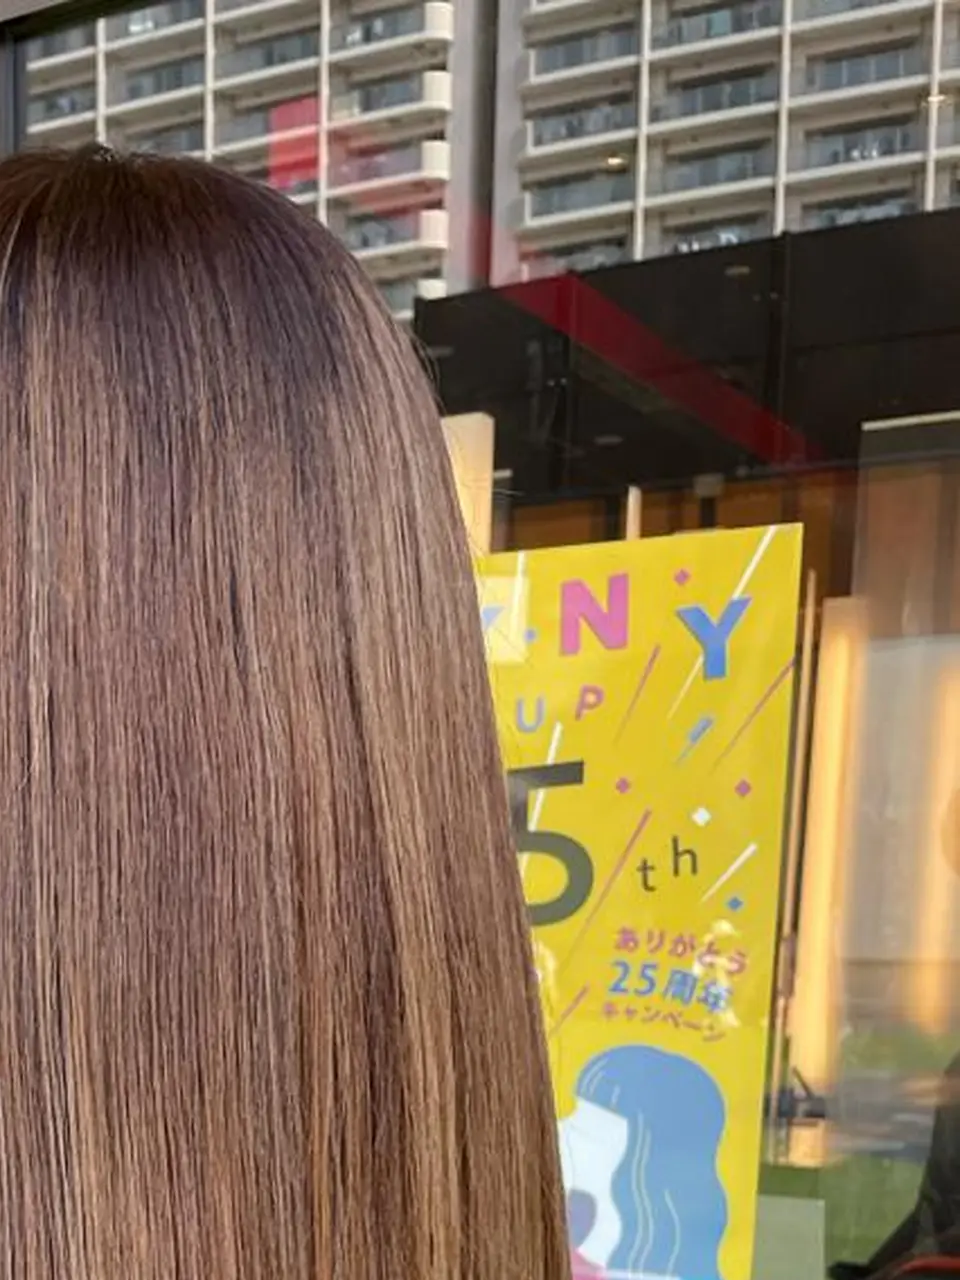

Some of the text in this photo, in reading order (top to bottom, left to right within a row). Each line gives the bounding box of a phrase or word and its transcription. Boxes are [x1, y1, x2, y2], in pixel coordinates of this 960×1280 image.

[614, 925, 748, 976] ありがとう
[608, 960, 733, 1014] 25周年
[602, 1001, 726, 1042] キャンペーン
